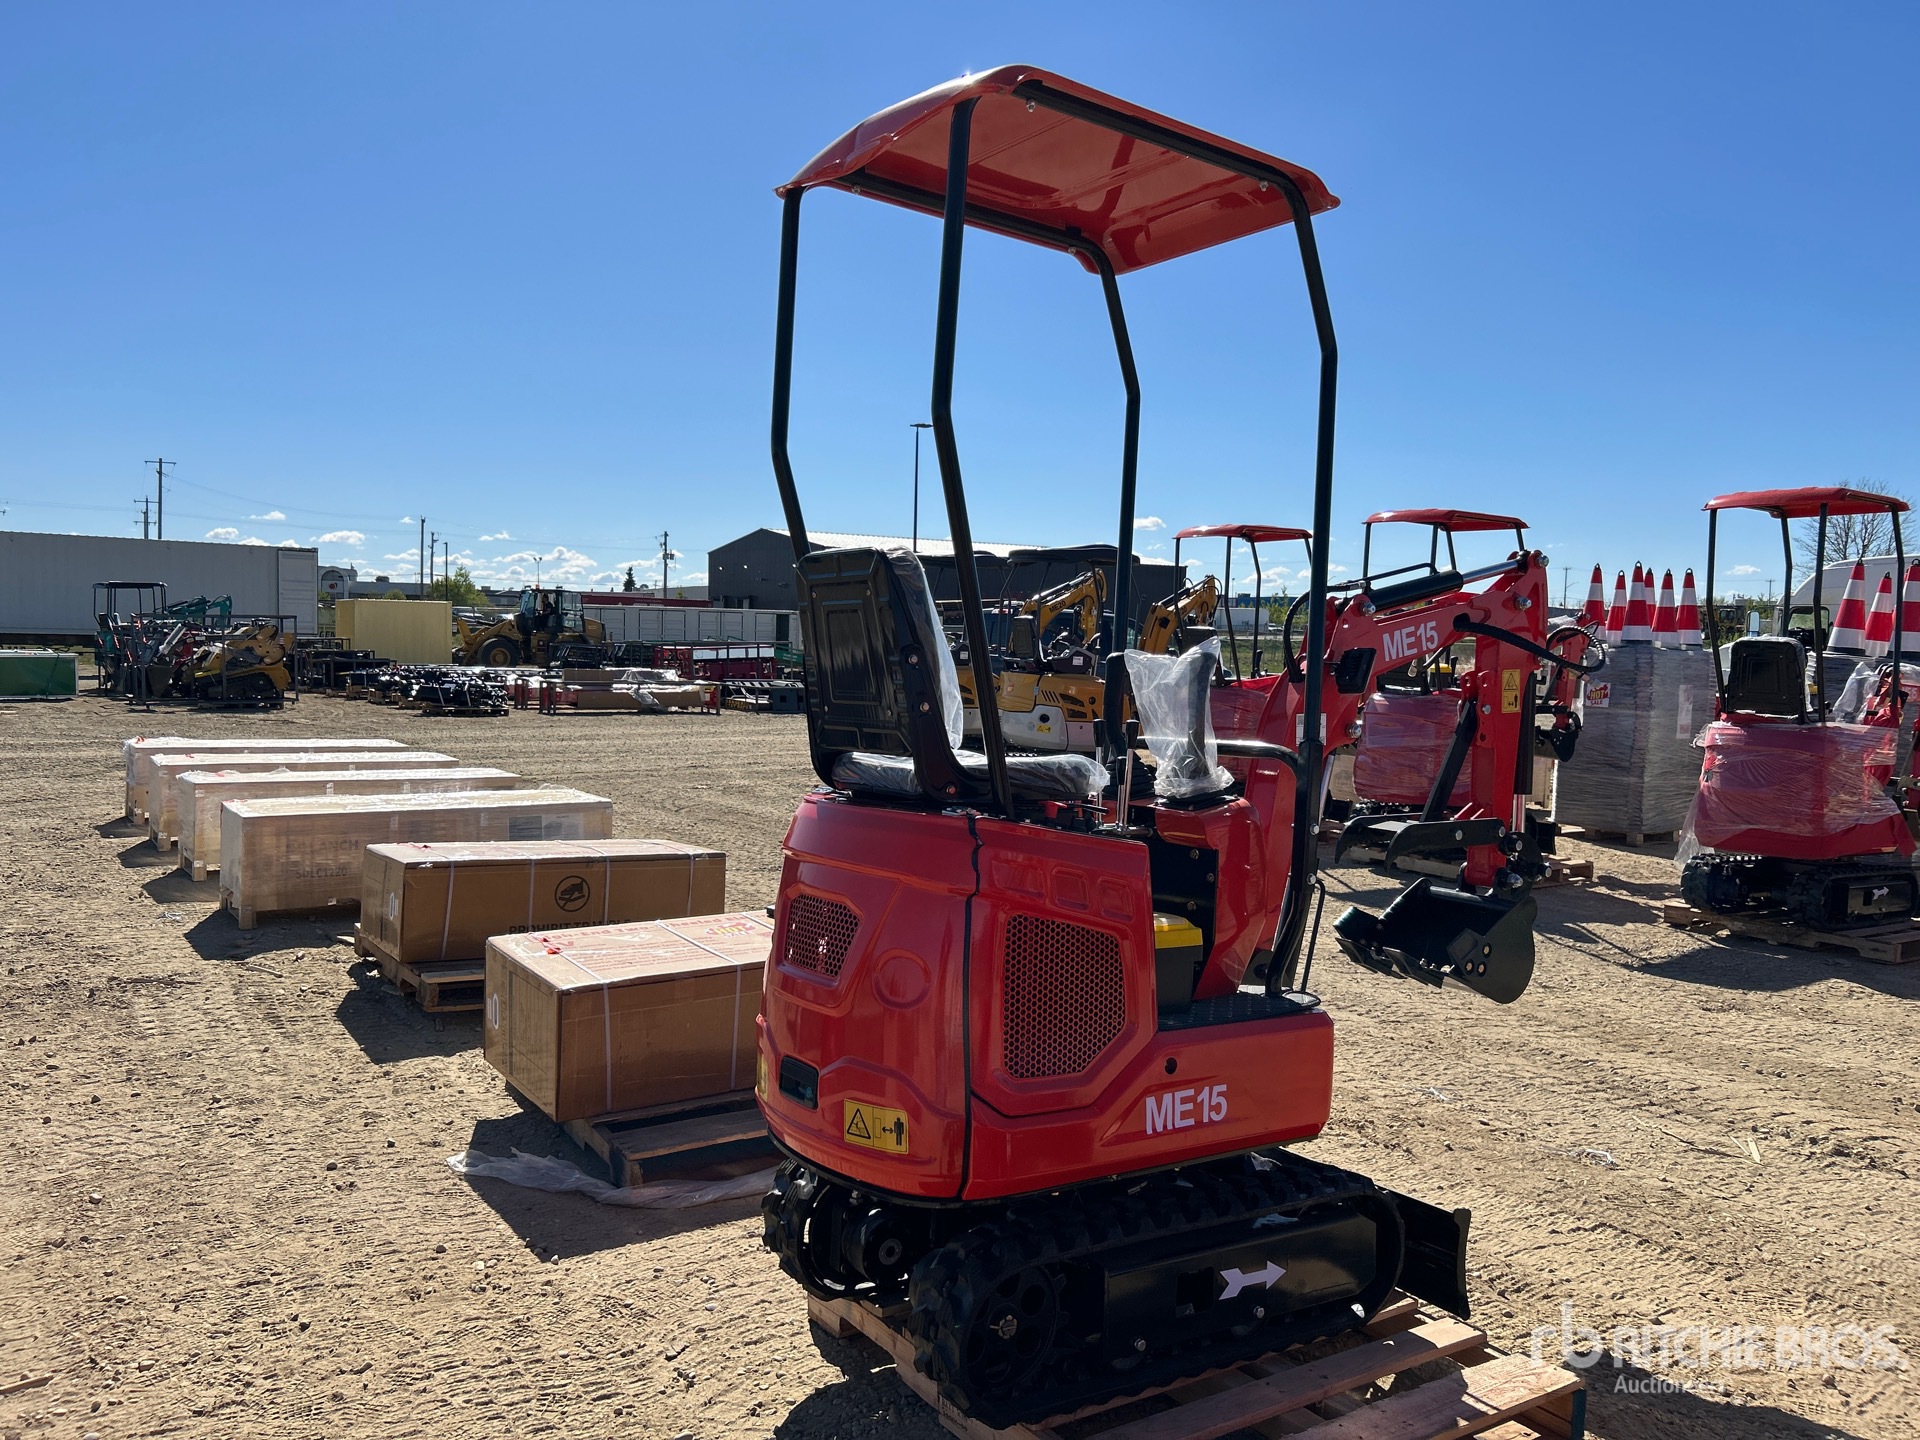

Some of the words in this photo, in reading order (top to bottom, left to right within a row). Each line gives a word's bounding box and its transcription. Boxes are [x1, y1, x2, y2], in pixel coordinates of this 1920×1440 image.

[1048, 600, 1067, 614] ME20
[1383, 621, 1439, 662] ME15
[1590, 690, 1605, 700] HOT
[1146, 1084, 1228, 1135] ME15
